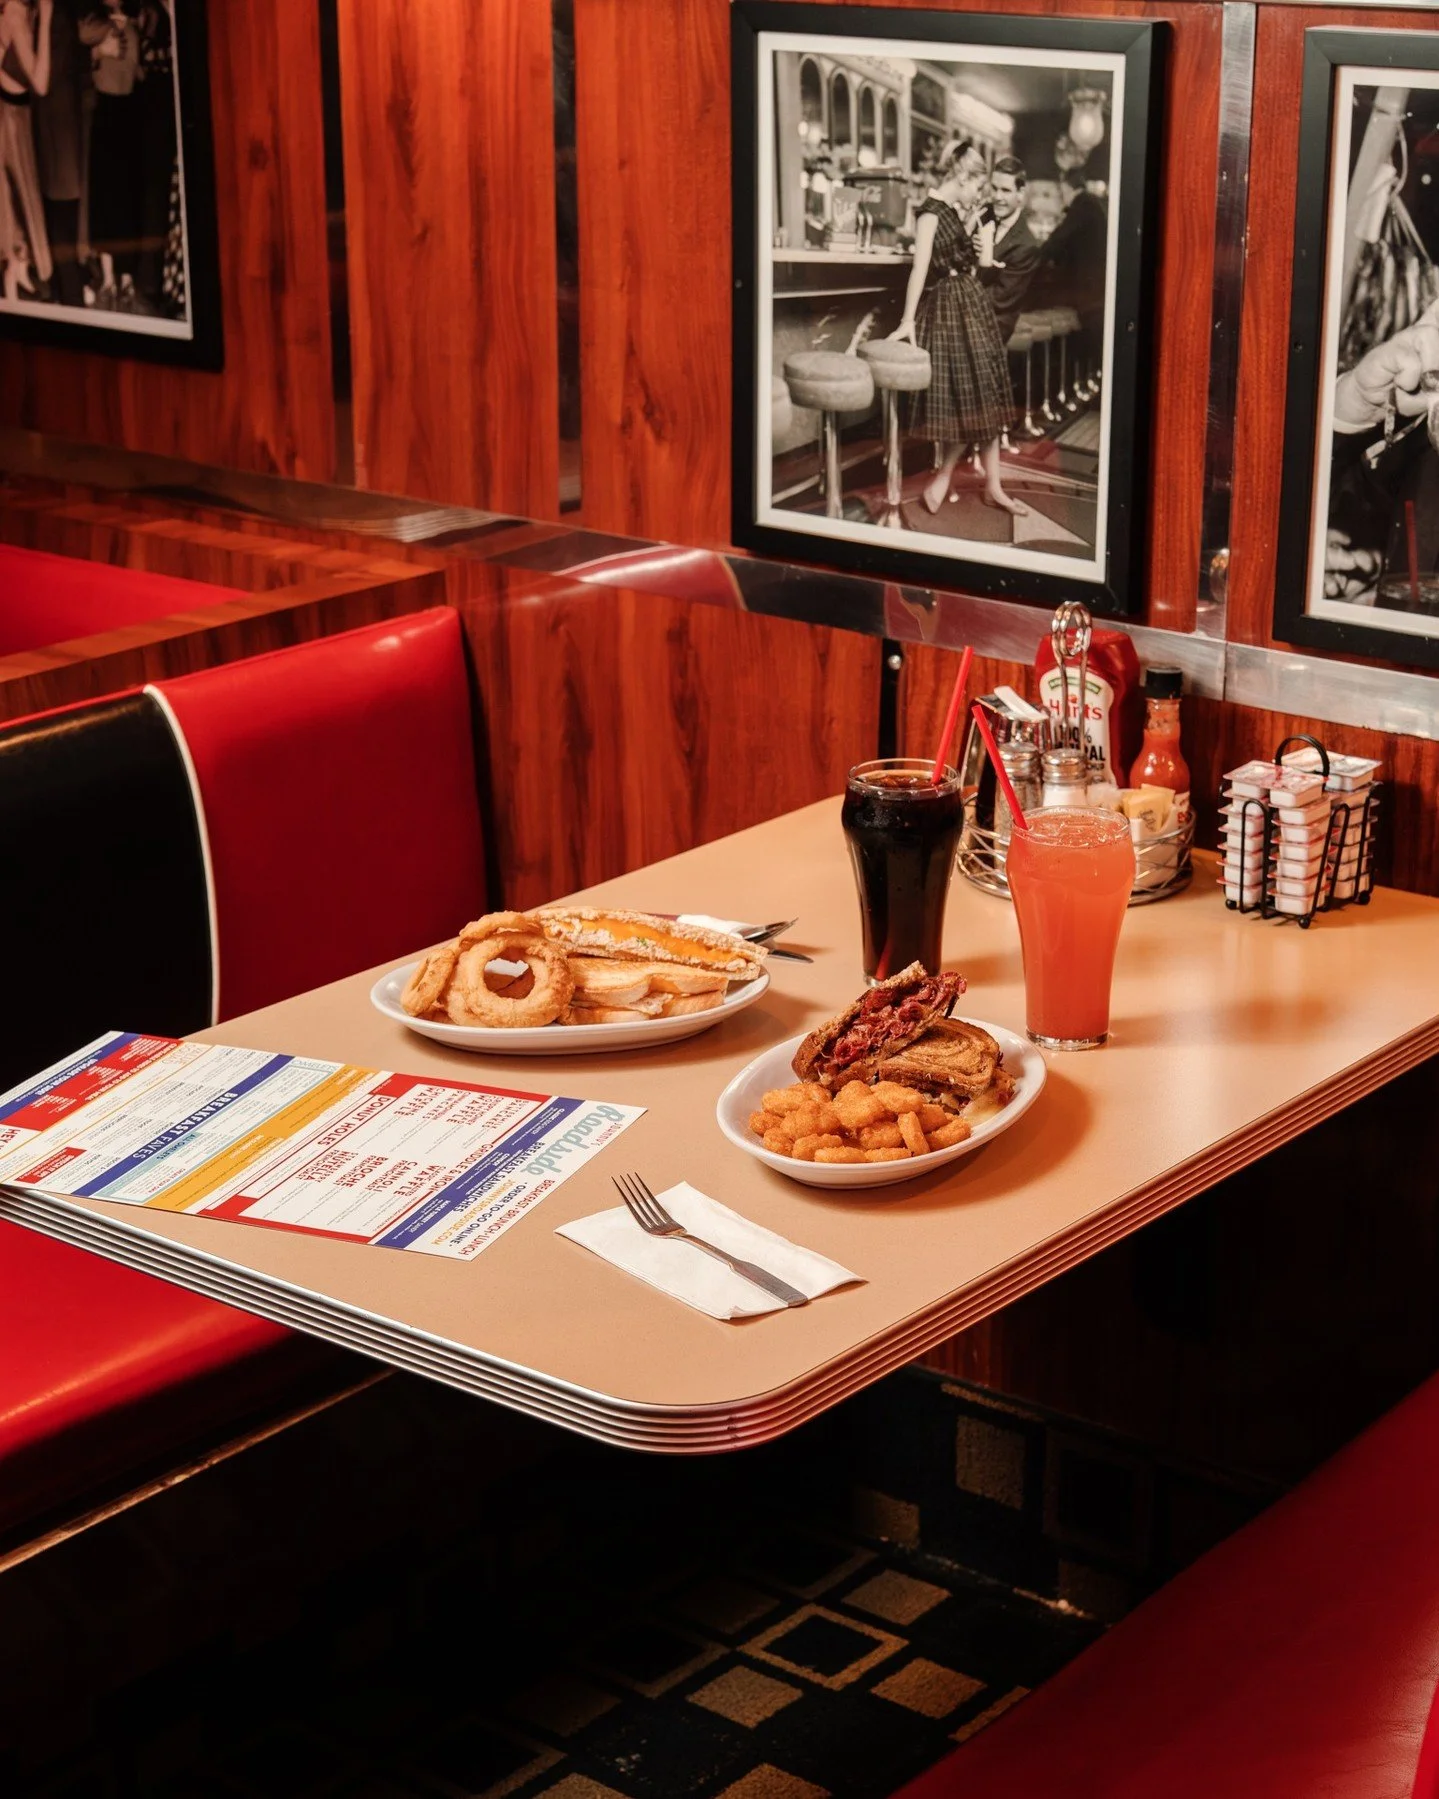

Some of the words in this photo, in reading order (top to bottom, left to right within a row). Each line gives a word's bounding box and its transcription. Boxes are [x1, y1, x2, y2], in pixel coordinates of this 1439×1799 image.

[165, 1092, 239, 1134] BREAKFAST
[348, 1096, 392, 1121] DONUT
[391, 1086, 438, 1115] WAFFLE
[419, 1090, 465, 1119] PANCAKES
[444, 1094, 490, 1122] WAFFLE
[480, 1099, 523, 1128] PANCAKES
[130, 1135, 174, 1158] FAVES
[314, 1122, 357, 1145] HOLES
[521, 1105, 625, 1177] Roadside
[300, 1150, 351, 1181] NUTELLA
[453, 1143, 495, 1170] GRIDDLE
[499, 1141, 546, 1173] BREAKFAST
[339, 1156, 389, 1187] BRIOCHE
[371, 1161, 419, 1192] CANNOLI
[391, 1164, 440, 1195] WAFFLE
[426, 1174, 455, 1191] IRON
[451, 1174, 506, 1212] SANDWICHES
[498, 1184, 526, 1203] ORDER
[513, 1179, 555, 1208] BREAKFAST
[474, 1203, 504, 1222] TO-GO
[483, 1209, 519, 1233] BRUNCH
[448, 1223, 481, 1244] ONLINE
[457, 1234, 489, 1255] LUNCH
